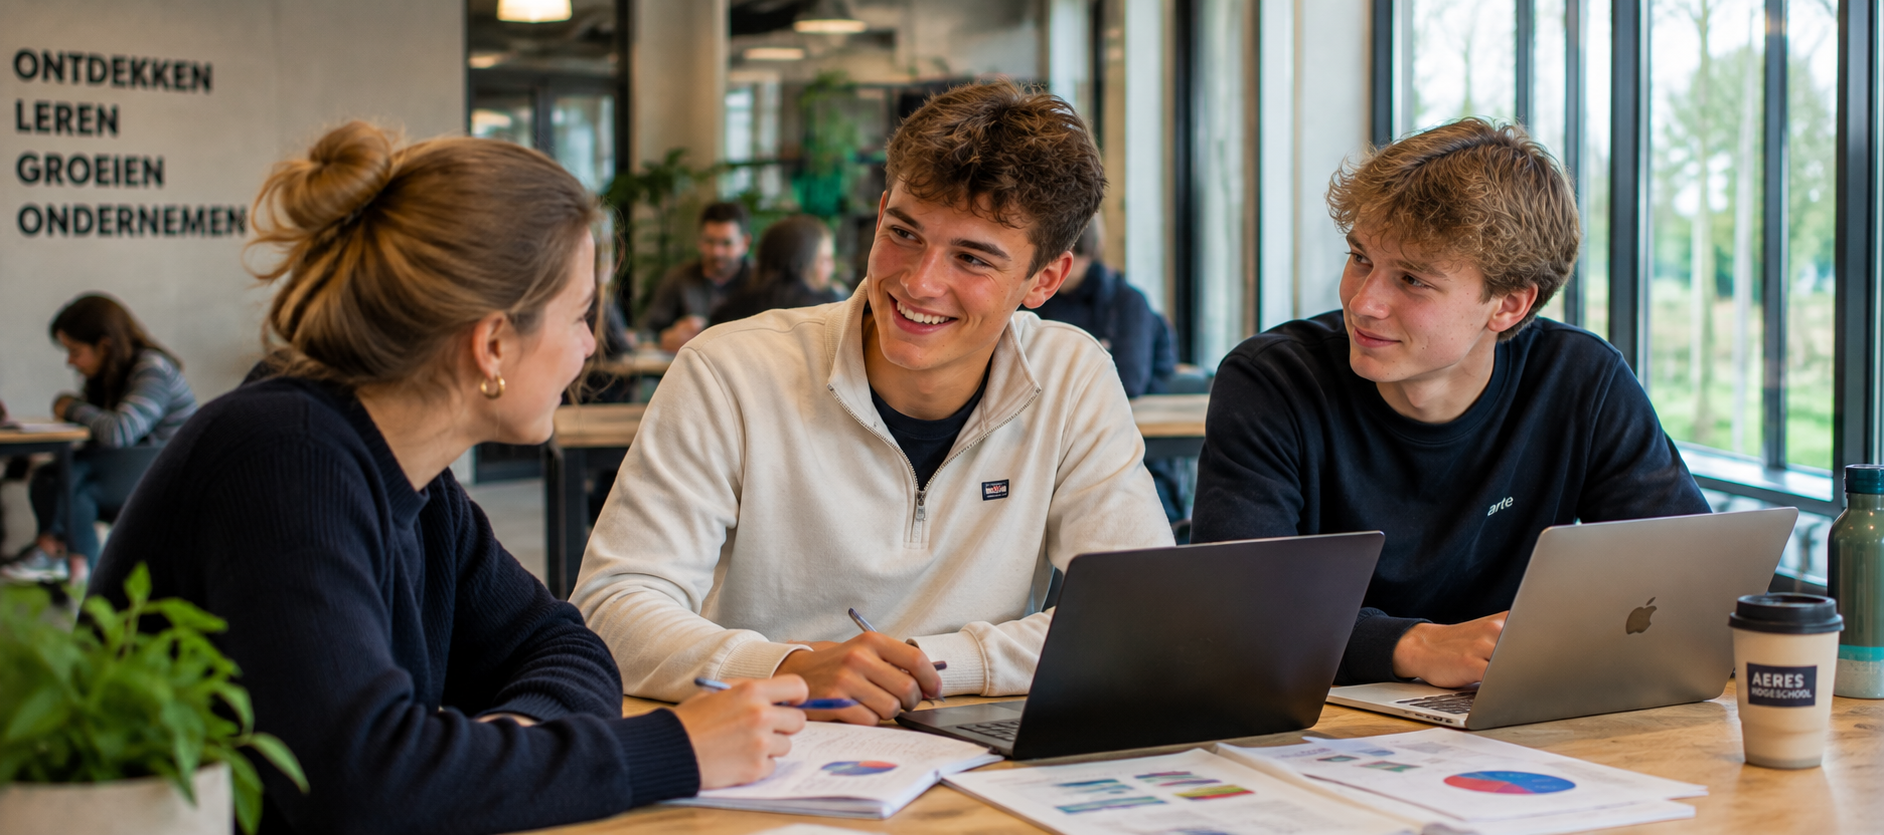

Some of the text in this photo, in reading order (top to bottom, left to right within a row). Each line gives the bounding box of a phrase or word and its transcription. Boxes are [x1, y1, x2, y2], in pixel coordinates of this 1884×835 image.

[13, 48, 213, 93] ONTDEKKEN
[15, 99, 120, 137] LEREN
[16, 152, 165, 188] GROEIEN
[17, 203, 247, 238] ONDERNEMEN
[1487, 496, 1514, 517] arte
[1751, 671, 1804, 688] AERES
[1751, 687, 1812, 699] HOGESCHOOL
